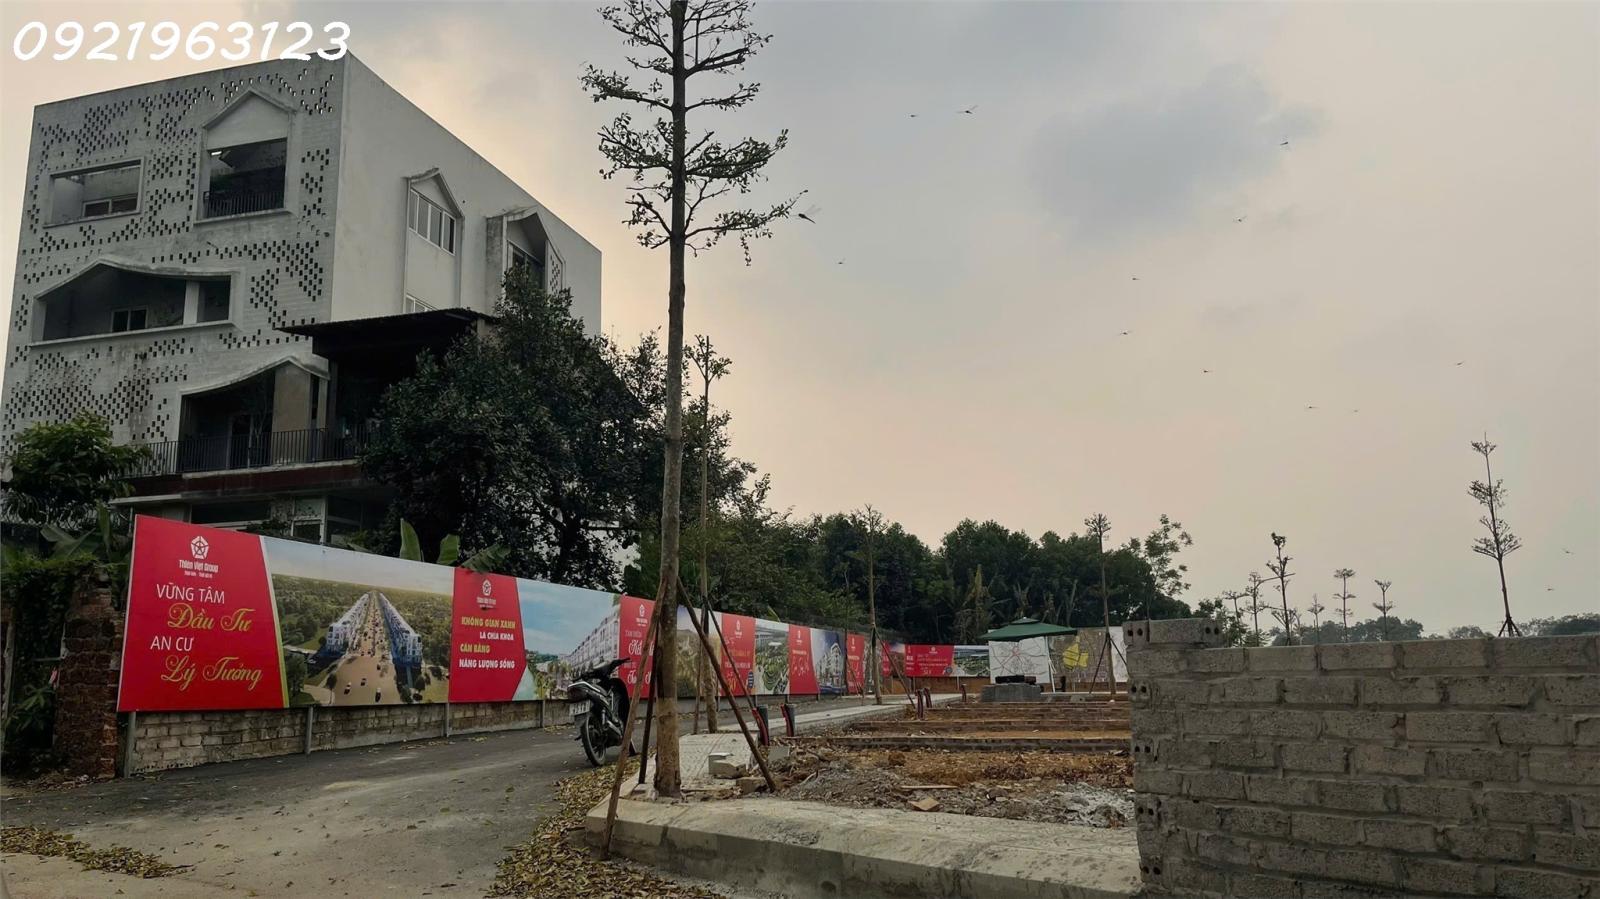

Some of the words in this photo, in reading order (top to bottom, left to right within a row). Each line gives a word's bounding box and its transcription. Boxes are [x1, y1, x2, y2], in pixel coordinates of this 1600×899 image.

[156, 582, 194, 602] VỮNG
[199, 586, 225, 604] TÂM
[167, 602, 215, 631] Đầu
[221, 608, 256, 632] Tư
[150, 636, 172, 651] AN
[176, 636, 194, 652] CƯ
[161, 655, 197, 692] Lý
[203, 656, 263, 691] Tưởng
